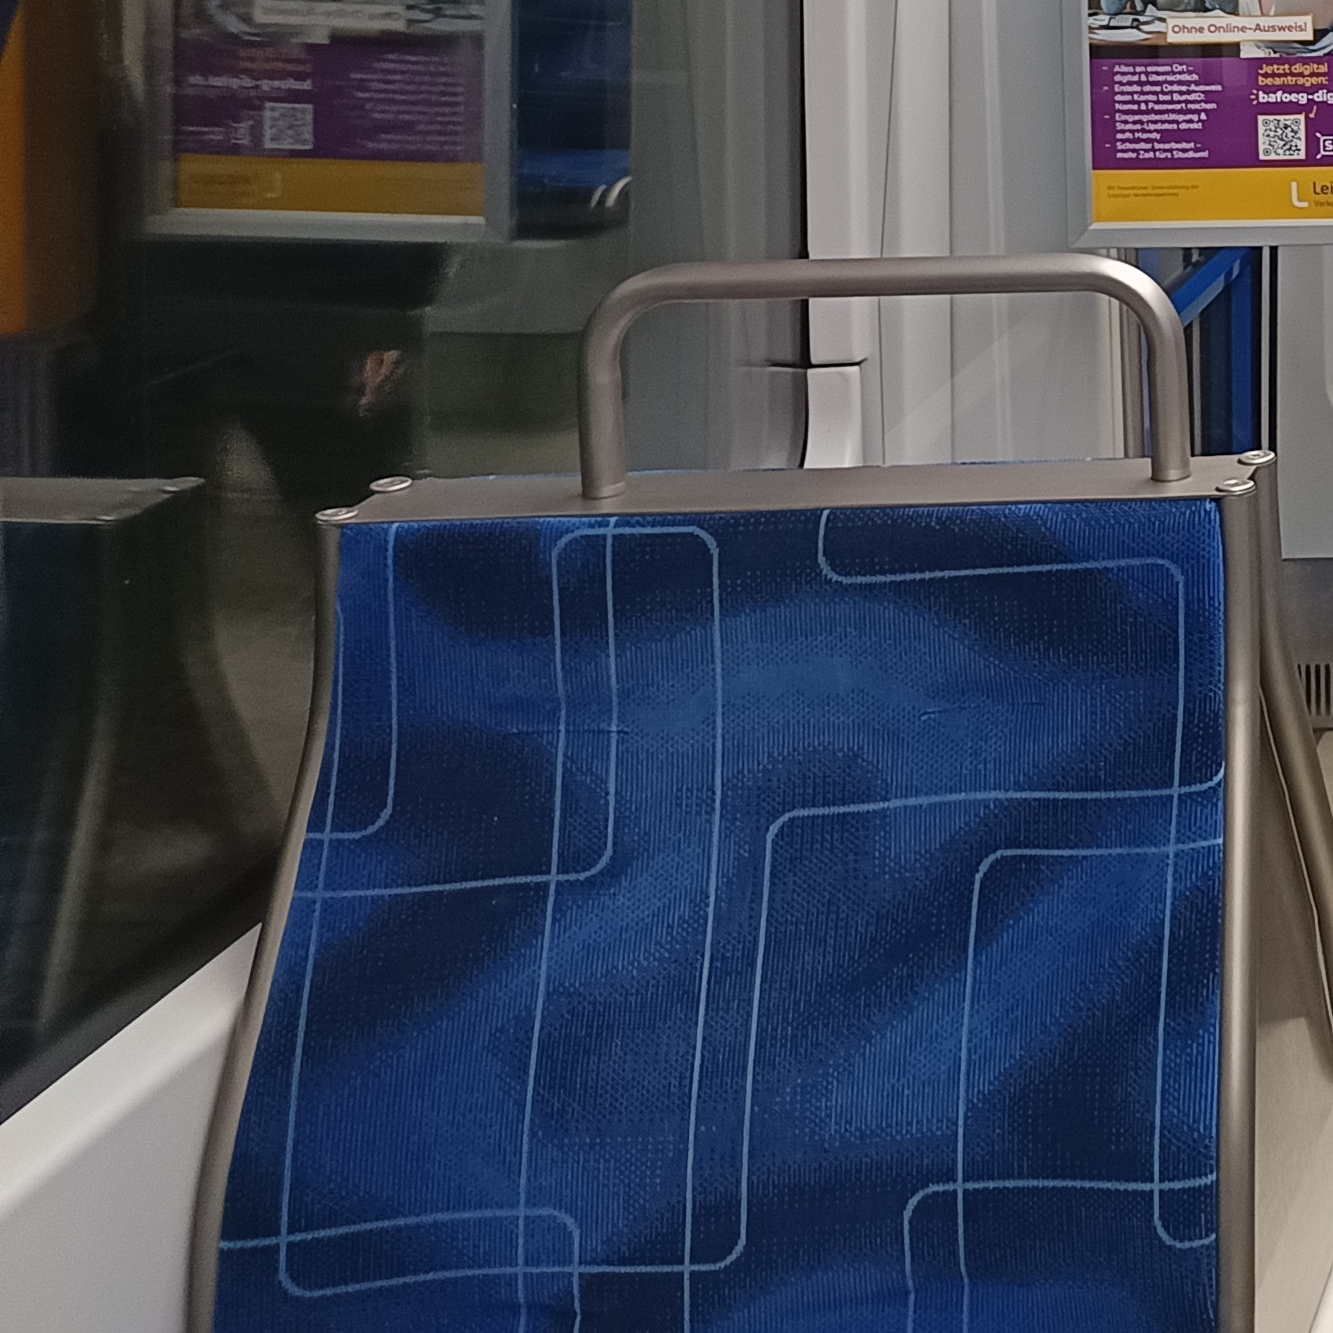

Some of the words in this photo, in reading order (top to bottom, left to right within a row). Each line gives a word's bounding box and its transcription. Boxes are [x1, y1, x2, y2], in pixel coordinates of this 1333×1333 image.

[1171, 24, 1205, 34] Ohne
[1207, 21, 1308, 34] Online-Ausweis!
[1172, 64, 1187, 72] Ort
[1258, 64, 1290, 74] Jetzt
[1292, 62, 1328, 76] digital
[1258, 76, 1329, 87] beantragen:
